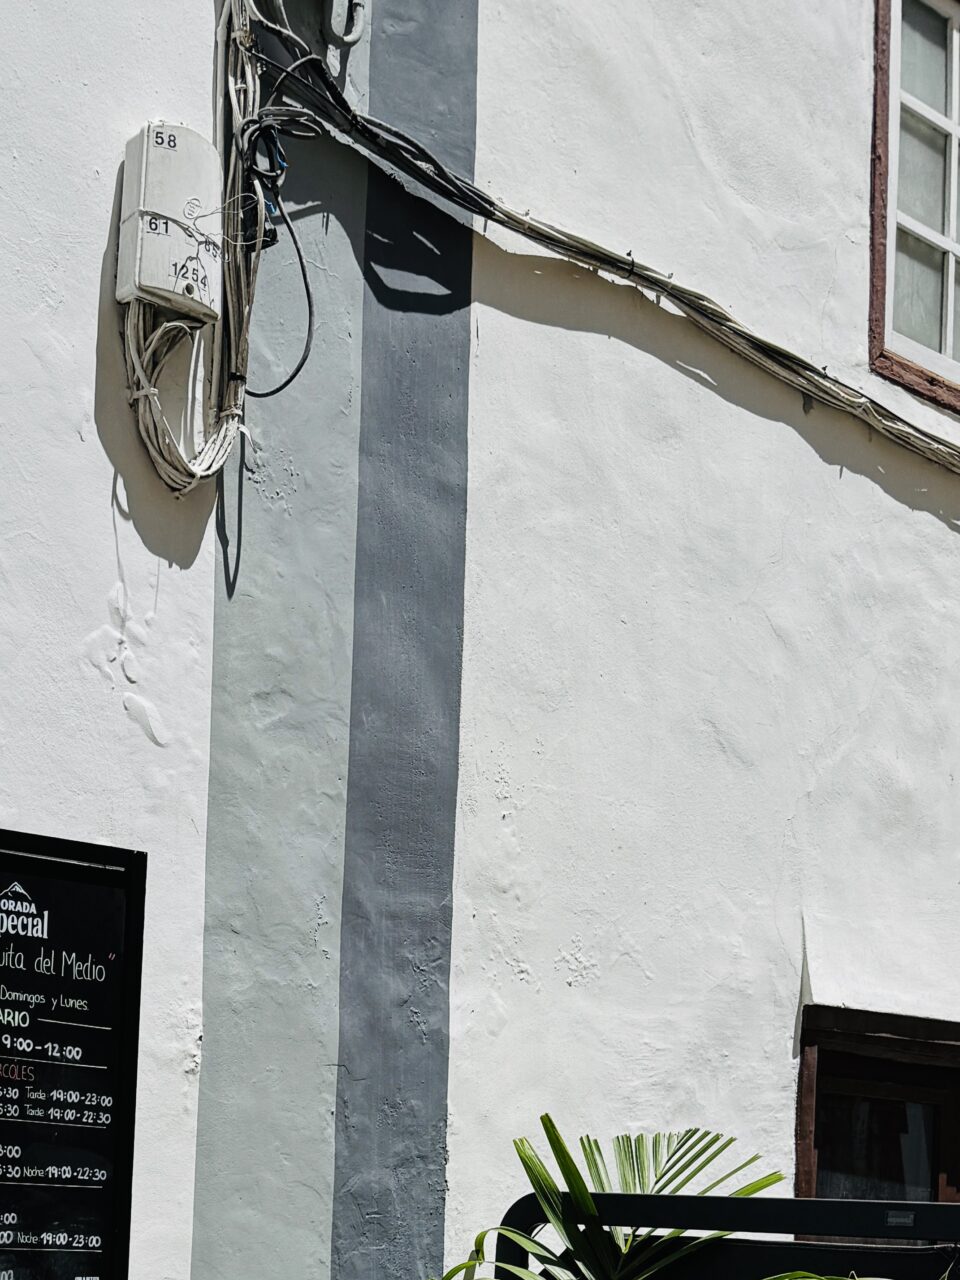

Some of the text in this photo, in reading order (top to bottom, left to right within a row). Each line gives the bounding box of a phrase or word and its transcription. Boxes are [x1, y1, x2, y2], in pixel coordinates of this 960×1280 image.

[155, 131, 178, 149] 58
[148, 217, 170, 234] 61
[172, 262, 208, 289] 1254
[34, 946, 56, 975] del
[0, 984, 46, 1009] Domingos
[51, 997, 58, 1011] y
